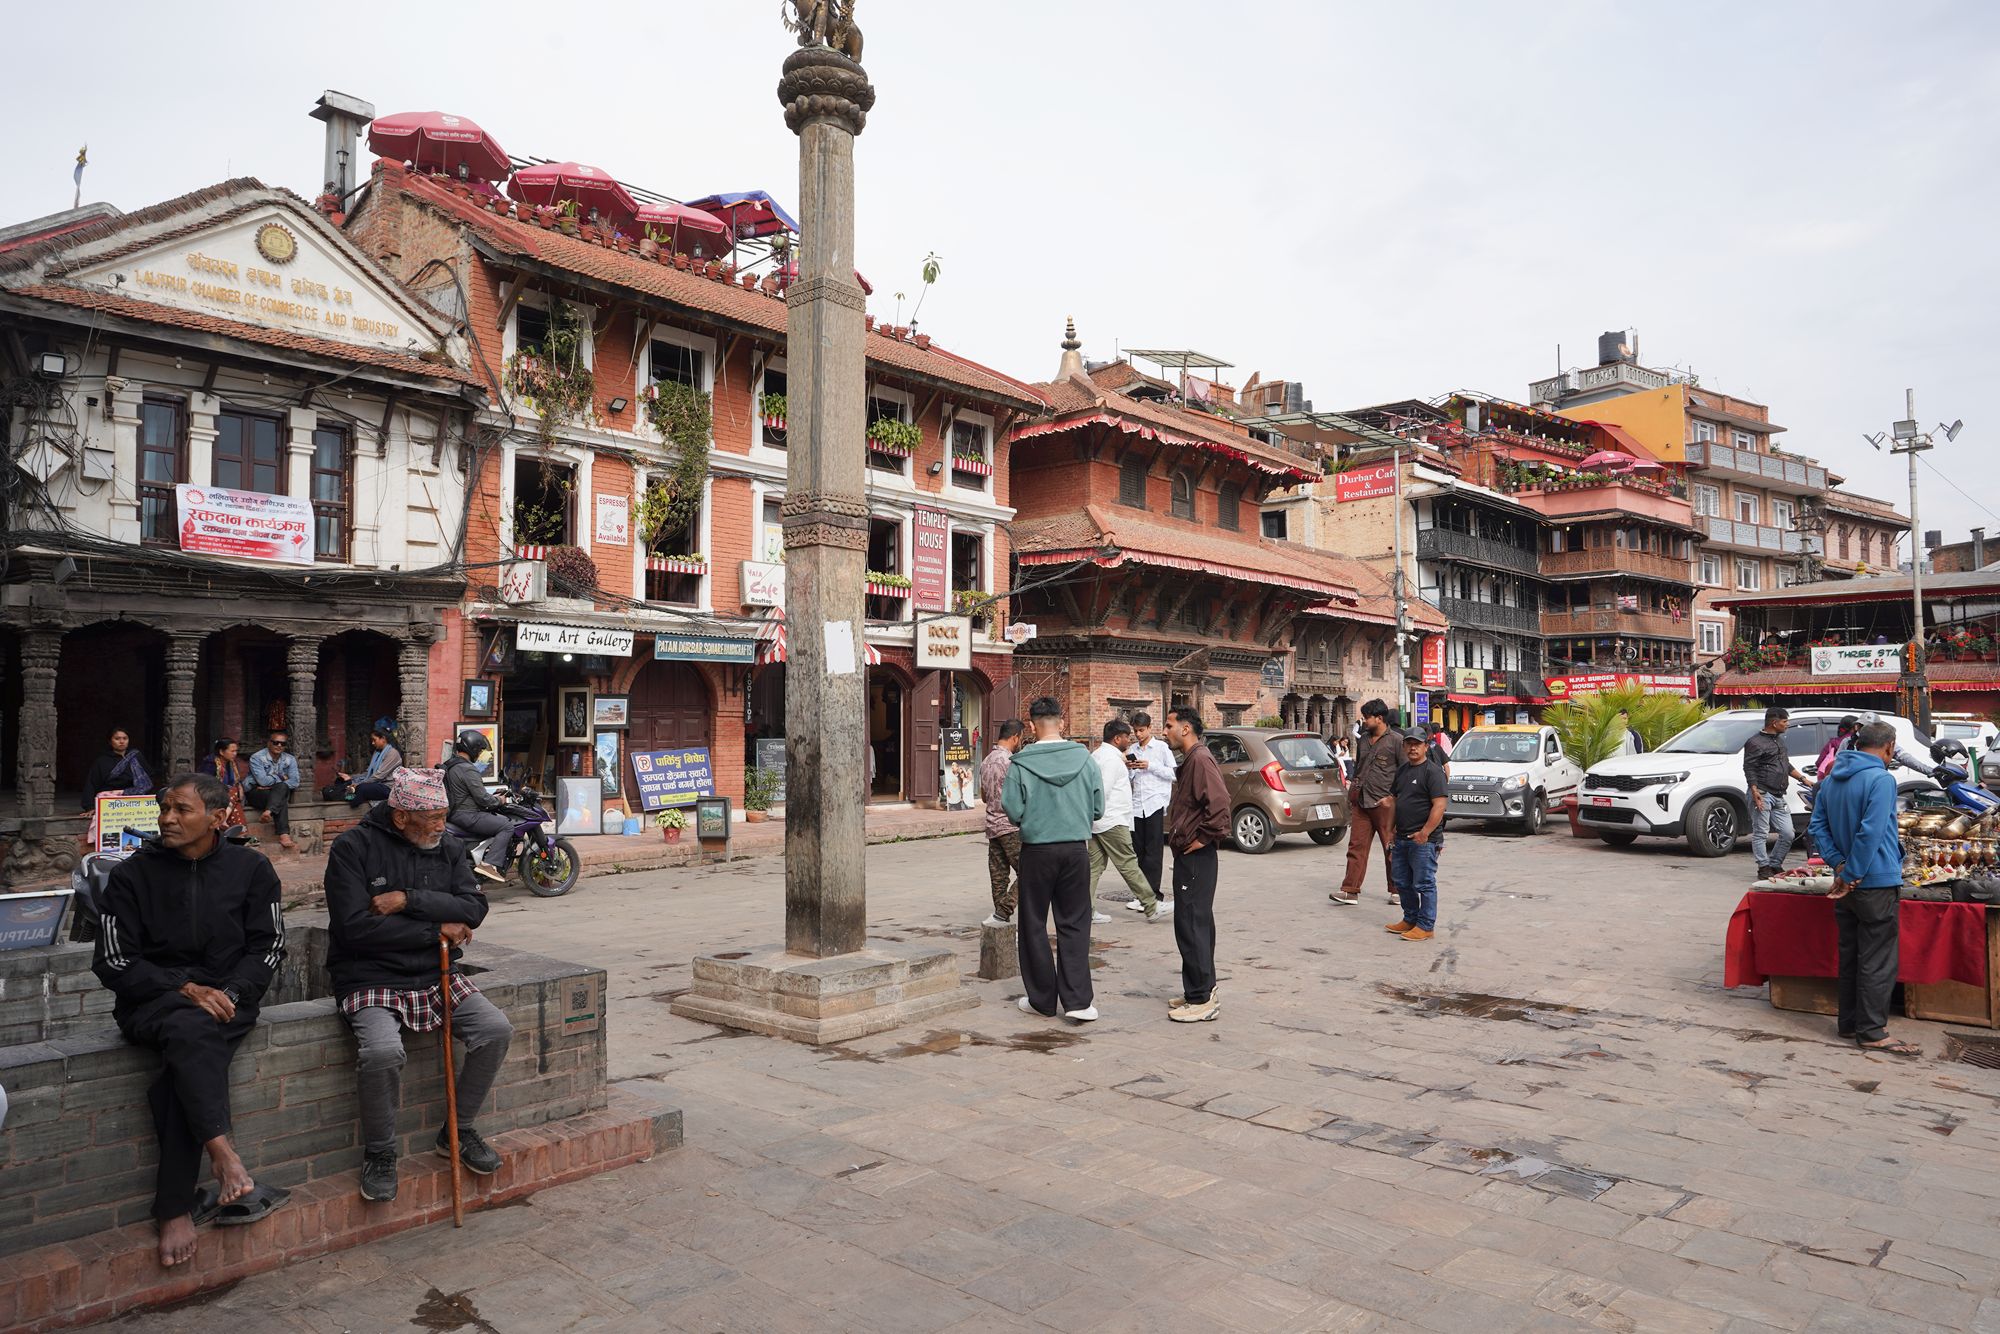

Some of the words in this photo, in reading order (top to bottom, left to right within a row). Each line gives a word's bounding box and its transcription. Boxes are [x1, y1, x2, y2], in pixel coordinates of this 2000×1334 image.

[134, 269, 187, 292] LALITPUR
[191, 281, 241, 304] CHAMBER
[244, 292, 257, 308] OF
[260, 297, 318, 320] COMMERCE
[325, 311, 346, 327] AND
[353, 316, 398, 337] INDUSTRY
[1339, 473, 1374, 485] Durbar
[1343, 485, 1394, 499] Restaurant
[599, 497, 626, 508] ESPRESSO
[187, 508, 242, 526] रक्तदान
[245, 517, 306, 534] कार्यक्रम
[918, 510, 946, 530] TEMPLE
[598, 532, 626, 543] Available
[918, 531, 944, 550] HOUSE
[750, 581, 779, 599] Cafe
[520, 627, 550, 645] Arjun
[558, 630, 580, 644] Art
[587, 631, 632, 651] Gallery
[927, 624, 960, 640] ROCK
[657, 640, 678, 653] PATAN
[679, 641, 703, 654] DURBAR
[927, 644, 960, 657] SHOP
[1837, 649, 1872, 658] THREE
[1877, 648, 1902, 657] STA
[683, 752, 706, 764] निषेध
[642, 772, 665, 783] सम्पदा
[666, 769, 687, 781] क्षेत्रमा
[687, 767, 708, 779] सवारी
[640, 783, 661, 793] साधन
[662, 780, 677, 791] पार्क
[696, 777, 712, 787] होला
[108, 799, 141, 810] मुक्तिनाथ
